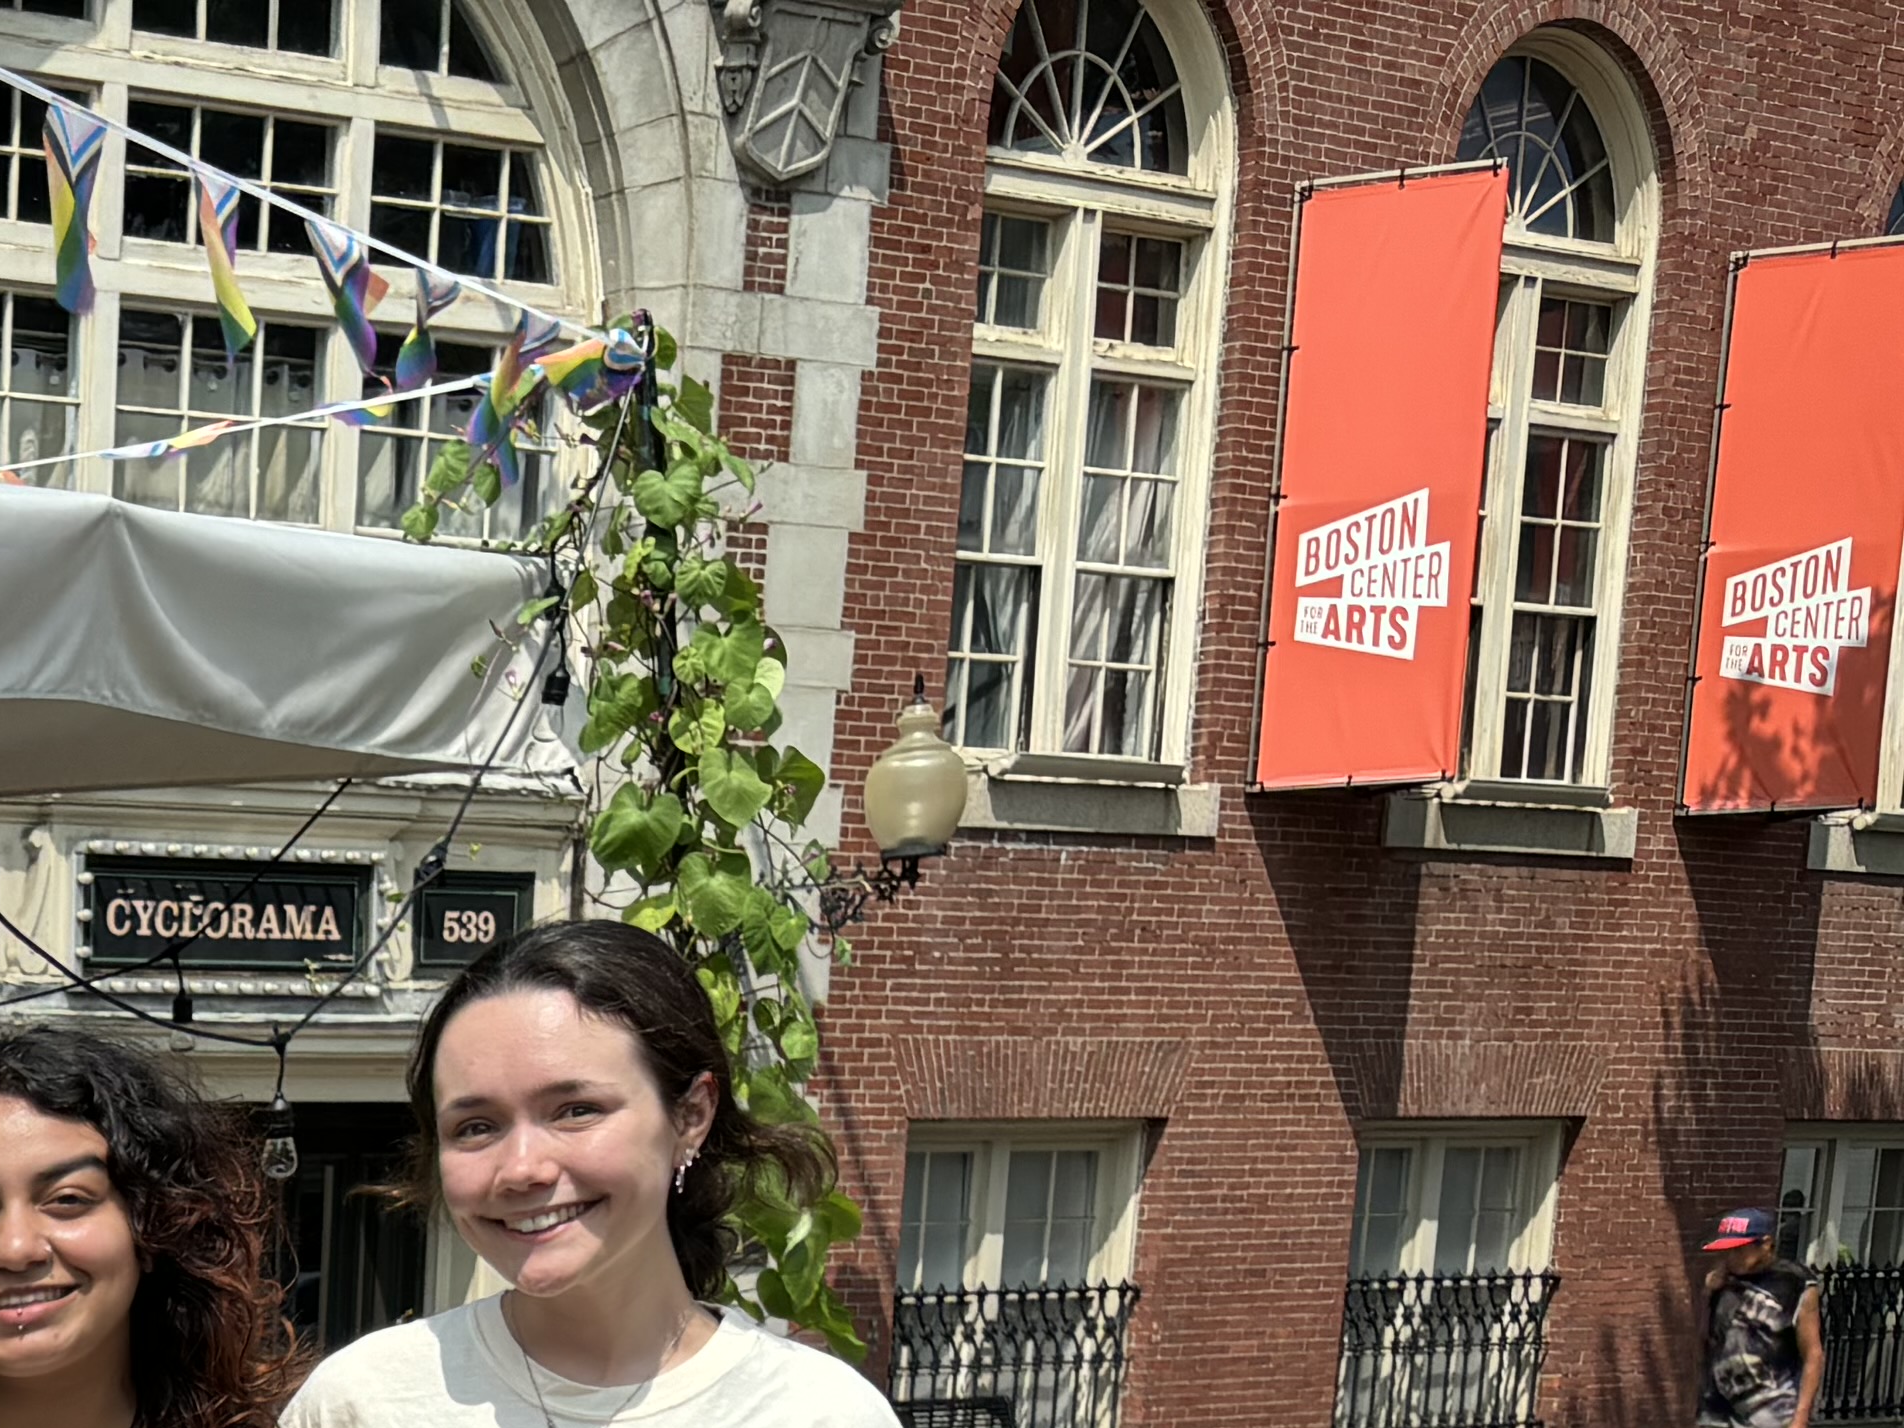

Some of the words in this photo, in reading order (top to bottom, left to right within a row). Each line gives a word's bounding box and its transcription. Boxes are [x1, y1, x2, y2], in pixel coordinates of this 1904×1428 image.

[1304, 497, 1419, 577] BOSTON
[1350, 550, 1442, 600] CENTER
[1730, 546, 1843, 618] BOSTON
[1300, 619, 1319, 635] THE
[1303, 605, 1324, 620] FOR
[1321, 603, 1410, 651] ARTS
[1774, 595, 1863, 641] CENTER
[1725, 656, 1743, 673] THE
[1729, 643, 1748, 657] FOR
[1745, 642, 1831, 688] ARTS
[106, 898, 342, 941] CYCLORAMA
[442, 910, 496, 944] 539
